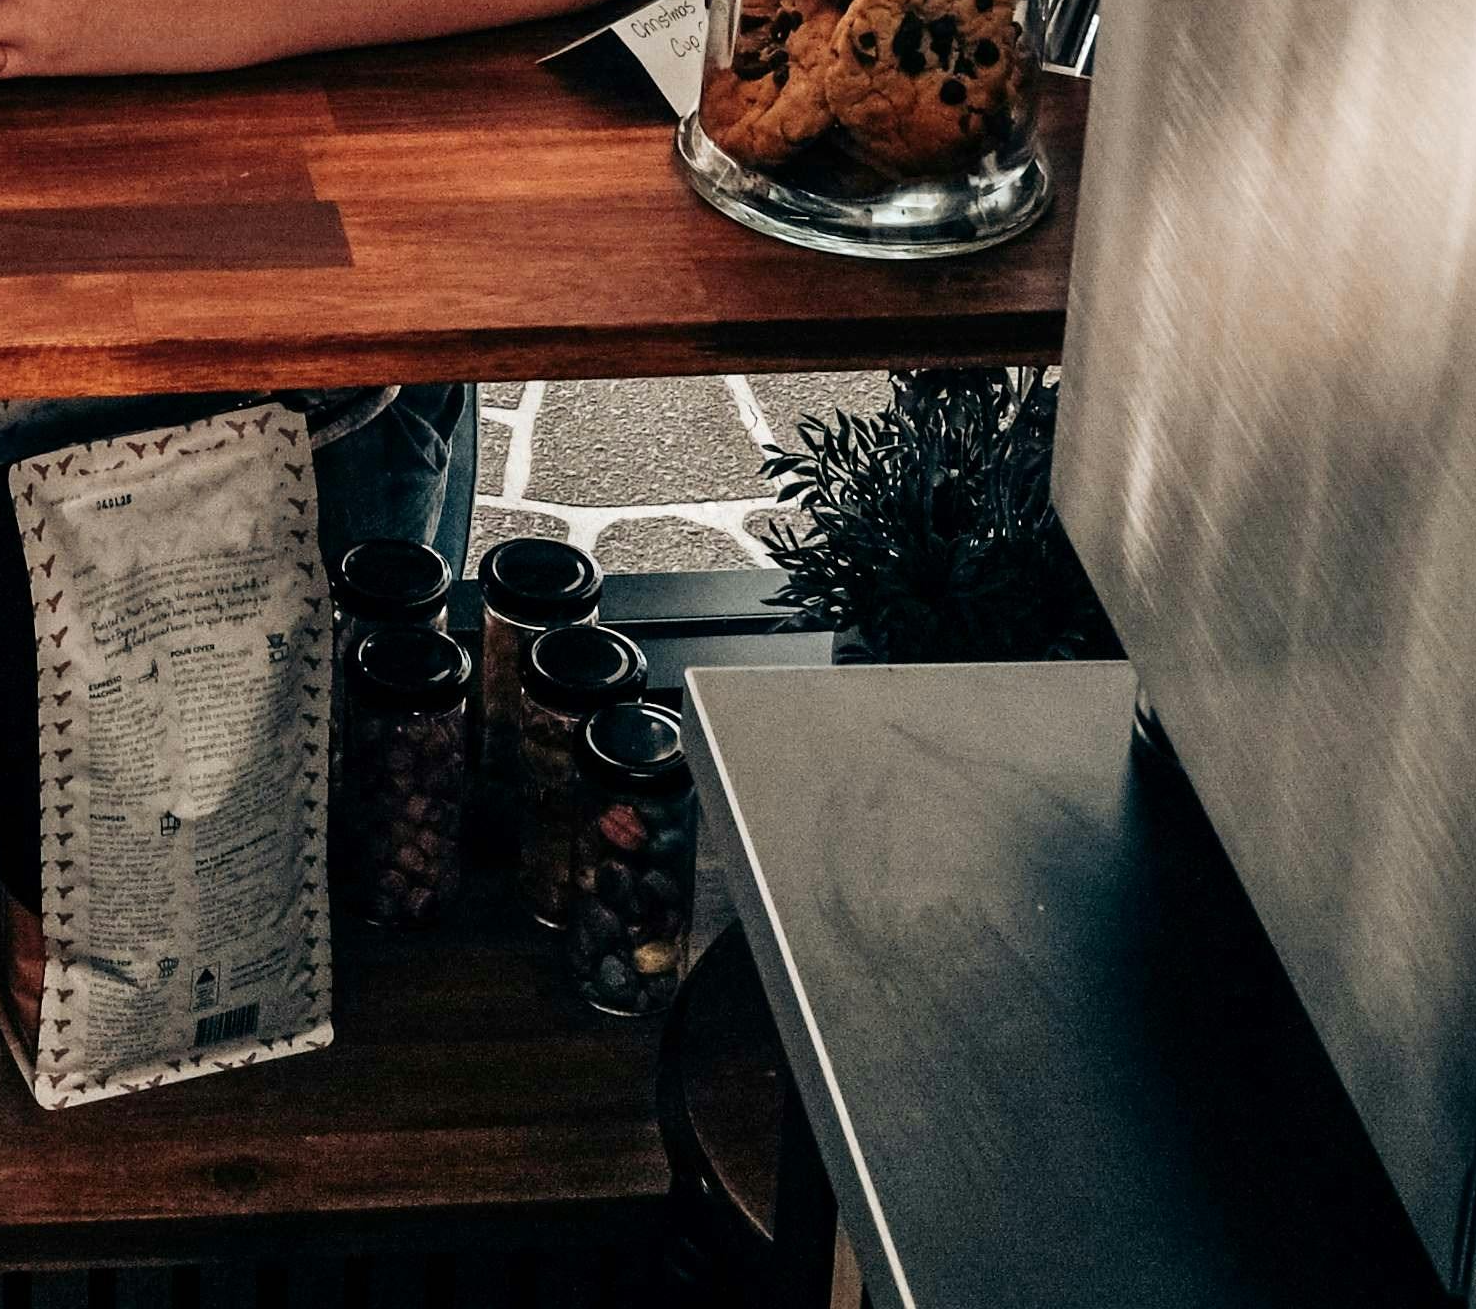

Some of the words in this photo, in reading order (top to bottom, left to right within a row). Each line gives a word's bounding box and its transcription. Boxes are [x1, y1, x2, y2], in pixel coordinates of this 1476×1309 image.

[170, 648, 191, 658] POUR
[193, 643, 215, 654] OVER
[89, 813, 125, 822] PLUNGER
